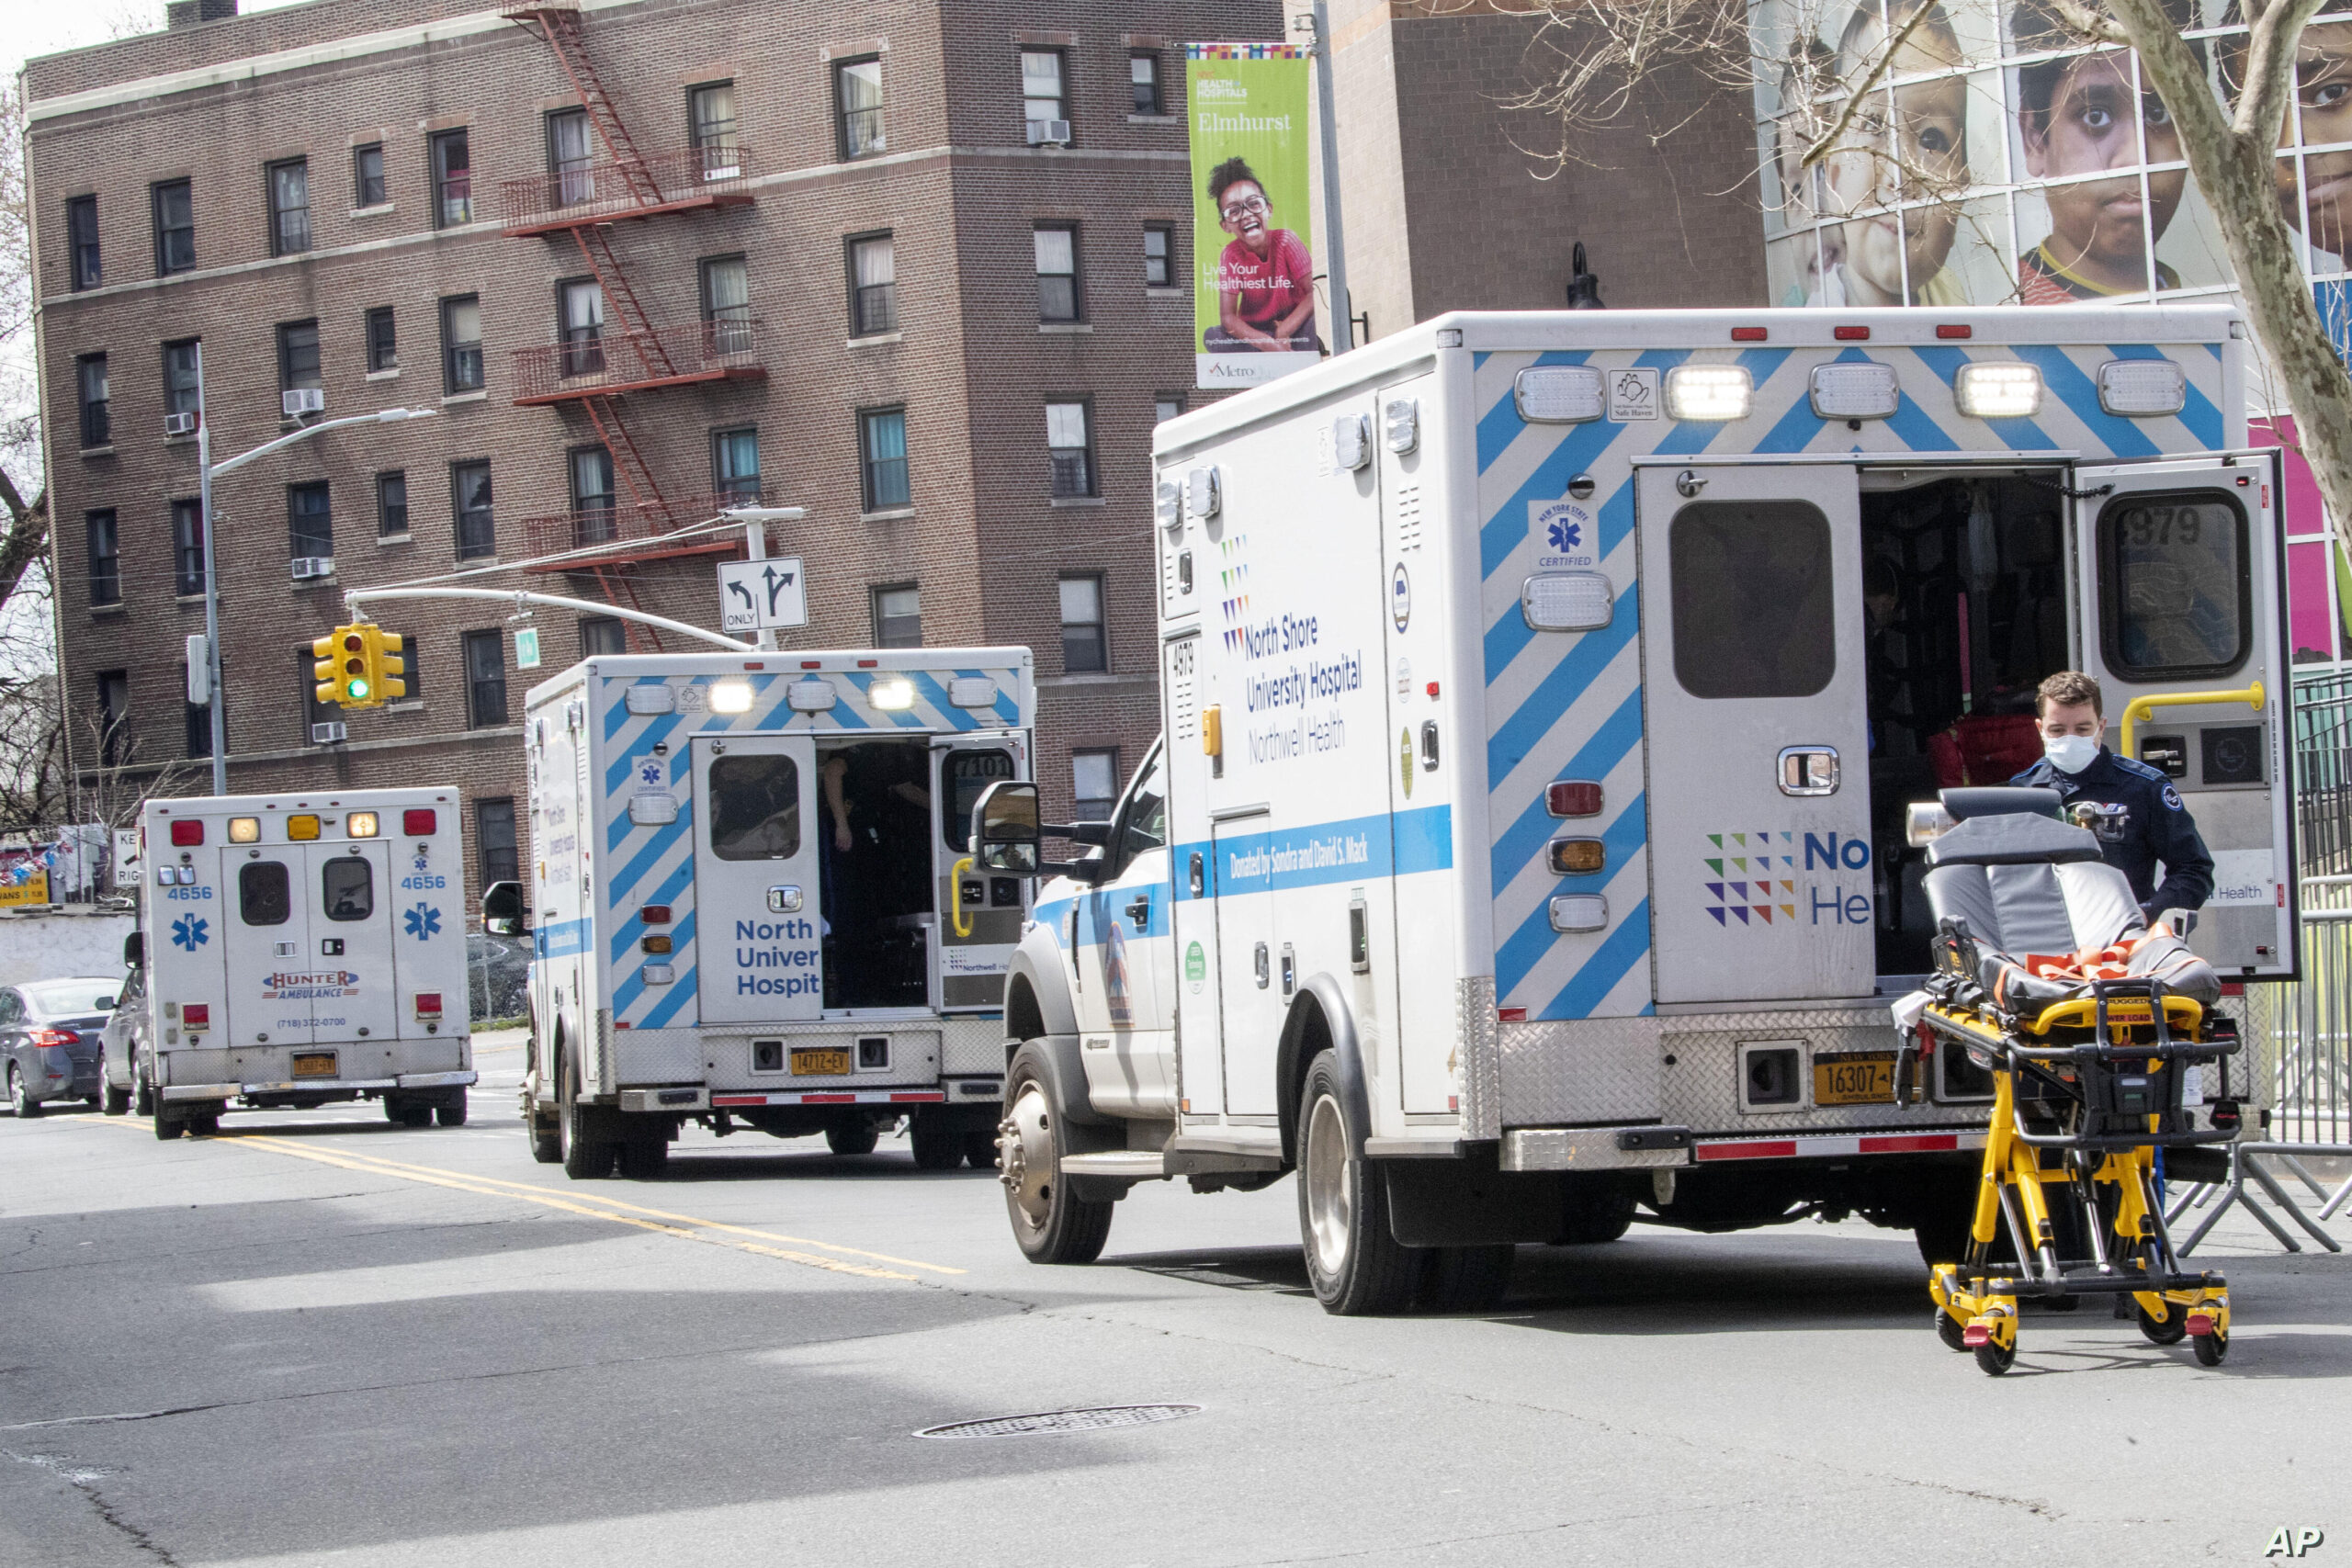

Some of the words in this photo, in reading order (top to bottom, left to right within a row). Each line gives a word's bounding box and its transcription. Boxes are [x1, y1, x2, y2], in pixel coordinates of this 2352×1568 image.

[1197, 88, 1248, 99] HOSPITALS
[1198, 112, 1292, 133] Elmhurst
[1203, 263, 1227, 276] Live
[1229, 262, 1259, 275] Your
[1204, 277, 1266, 291] Healthiest
[1268, 276, 1295, 289] Life.
[1539, 509, 1553, 523] NEW
[1553, 504, 1570, 513] YORK
[1572, 506, 1589, 522] STATE
[2124, 507, 2201, 545] 979
[1539, 557, 1592, 567] CERTIFIED
[727, 614, 755, 626] ONLY
[1245, 617, 1279, 661] North
[1283, 612, 1317, 652] Shore
[1173, 641, 1194, 678] 4979
[1247, 665, 1306, 713] University
[1310, 649, 1362, 703] Hospital
[1250, 716, 1305, 765] Northwell
[1308, 709, 1346, 754] Health
[120, 834, 136, 845] KE
[1230, 846, 1261, 879] Donated
[1261, 846, 1271, 884] by
[1272, 842, 1297, 874] Sondra
[1298, 839, 1313, 869] and
[1314, 836, 1337, 868] David
[1346, 832, 1368, 863] Mack
[1804, 832, 1870, 870] No
[119, 871, 140, 882] RIG
[401, 875, 446, 890] 4656
[167, 886, 212, 900] 4656
[2219, 886, 2262, 899] Health
[1812, 886, 1870, 925] He
[737, 919, 813, 940] North
[737, 946, 820, 967] Univer
[963, 964, 997, 972] Northwell
[273, 971, 349, 989] HUNTER
[738, 973, 820, 998] Hospit
[278, 988, 343, 999] AMBULANCE
[277, 1020, 301, 1029] (718)
[303, 1018, 346, 1027] 372-0700
